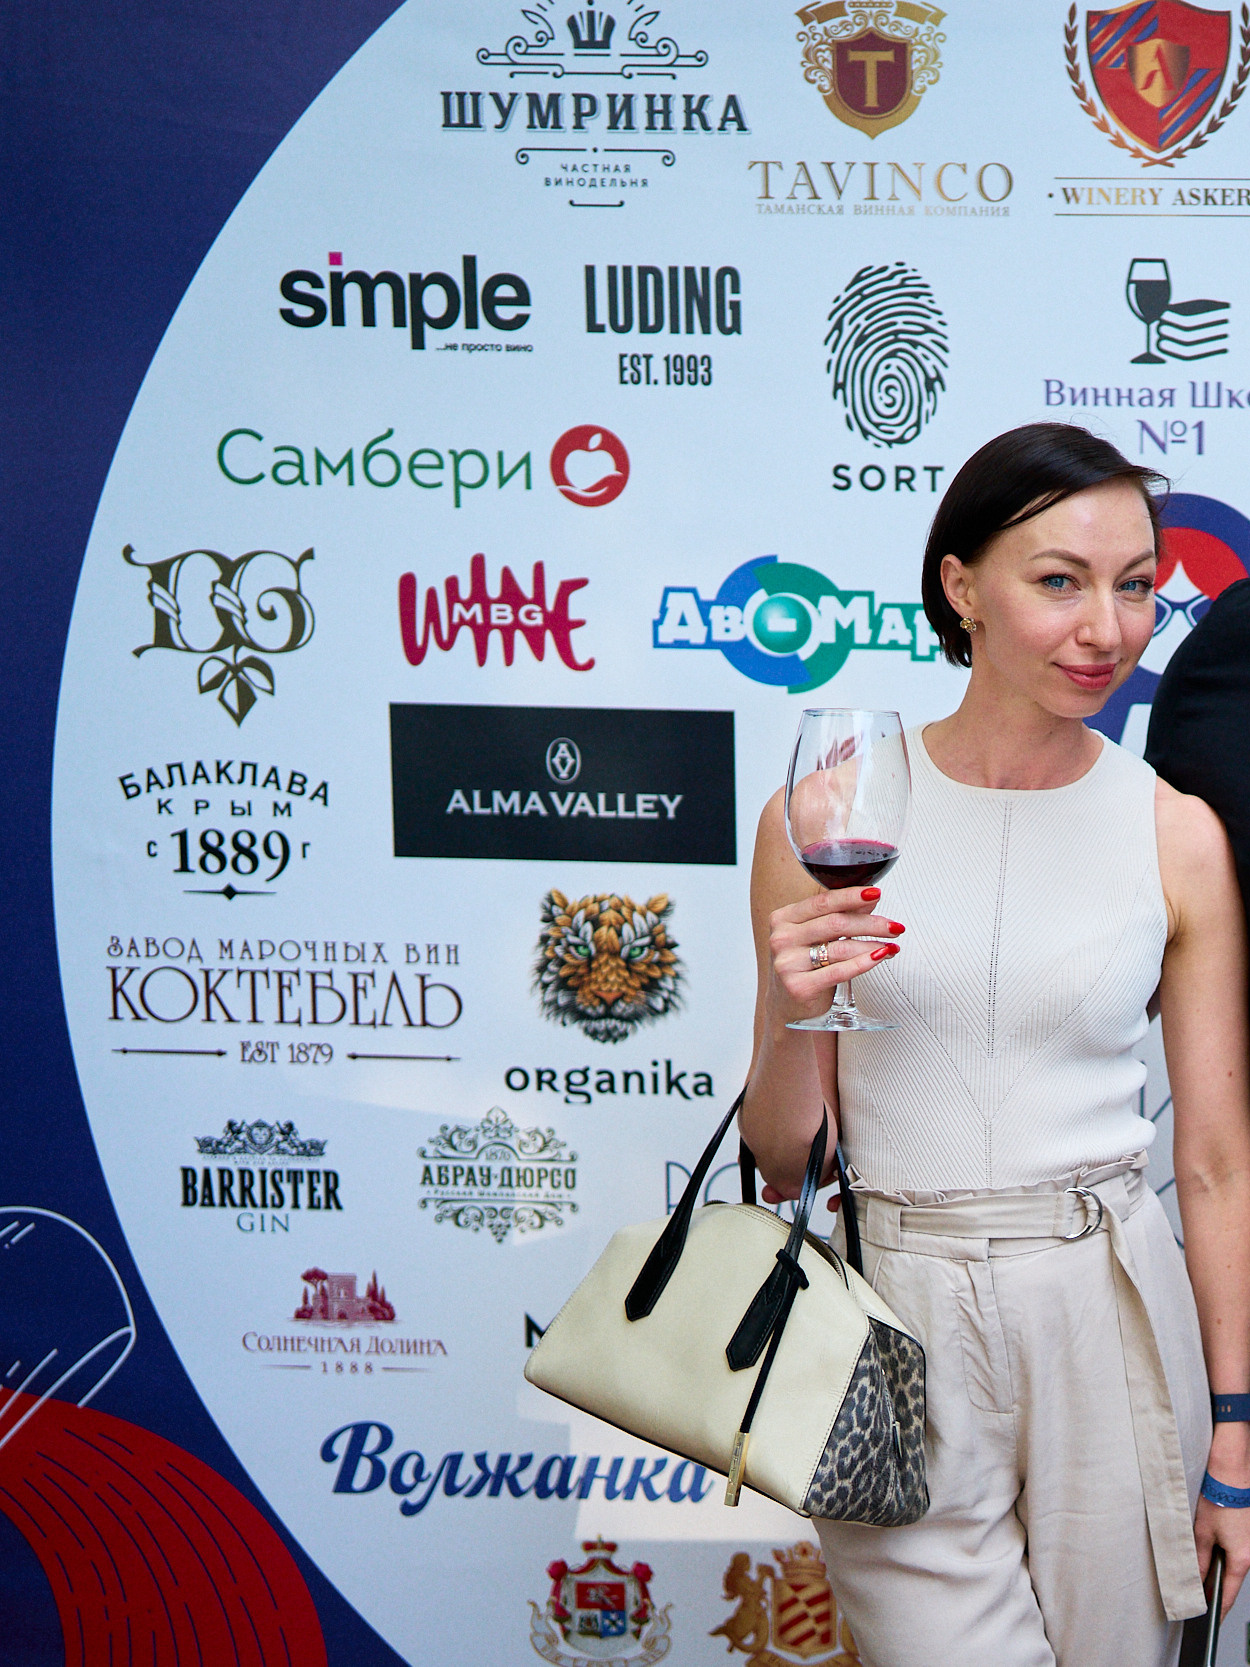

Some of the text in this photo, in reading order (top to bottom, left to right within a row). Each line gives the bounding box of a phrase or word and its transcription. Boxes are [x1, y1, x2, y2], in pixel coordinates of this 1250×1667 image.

[440, 91, 748, 131] ШУМРИНКА
[544, 177, 648, 188] ВИНОДЕЛЬНЯ
[561, 163, 630, 173] ЧАСТНАЯ
[748, 161, 1013, 202] TAVINCO
[755, 203, 1010, 217] ТАМАНСКАЯ ВИННАЯ КОМПАНИЯ
[1061, 187, 1162, 205] WINERY
[279, 252, 532, 352] simple
[585, 265, 741, 335] LUDING
[619, 353, 712, 386] EST. 1993
[1044, 379, 1176, 408] Винная
[217, 428, 531, 508] Самбери
[833, 464, 944, 492] SORT
[452, 602, 546, 628] MBG
[117, 758, 330, 808] БАЛАКЛАВА
[447, 789, 684, 820] ALMA VALLEY
[171, 829, 290, 882] 1889
[107, 935, 459, 965] ЗАВОД МАРОЧНЫХ ВИН
[106, 966, 463, 1028] КОКТЕБЕЛЬ
[240, 1041, 334, 1065] EST 1879
[179, 1165, 345, 1212] BARRISTER
[236, 1213, 289, 1233] GIN
[322, 1361, 373, 1374] 1888
[319, 1420, 717, 1518] Волжанка
